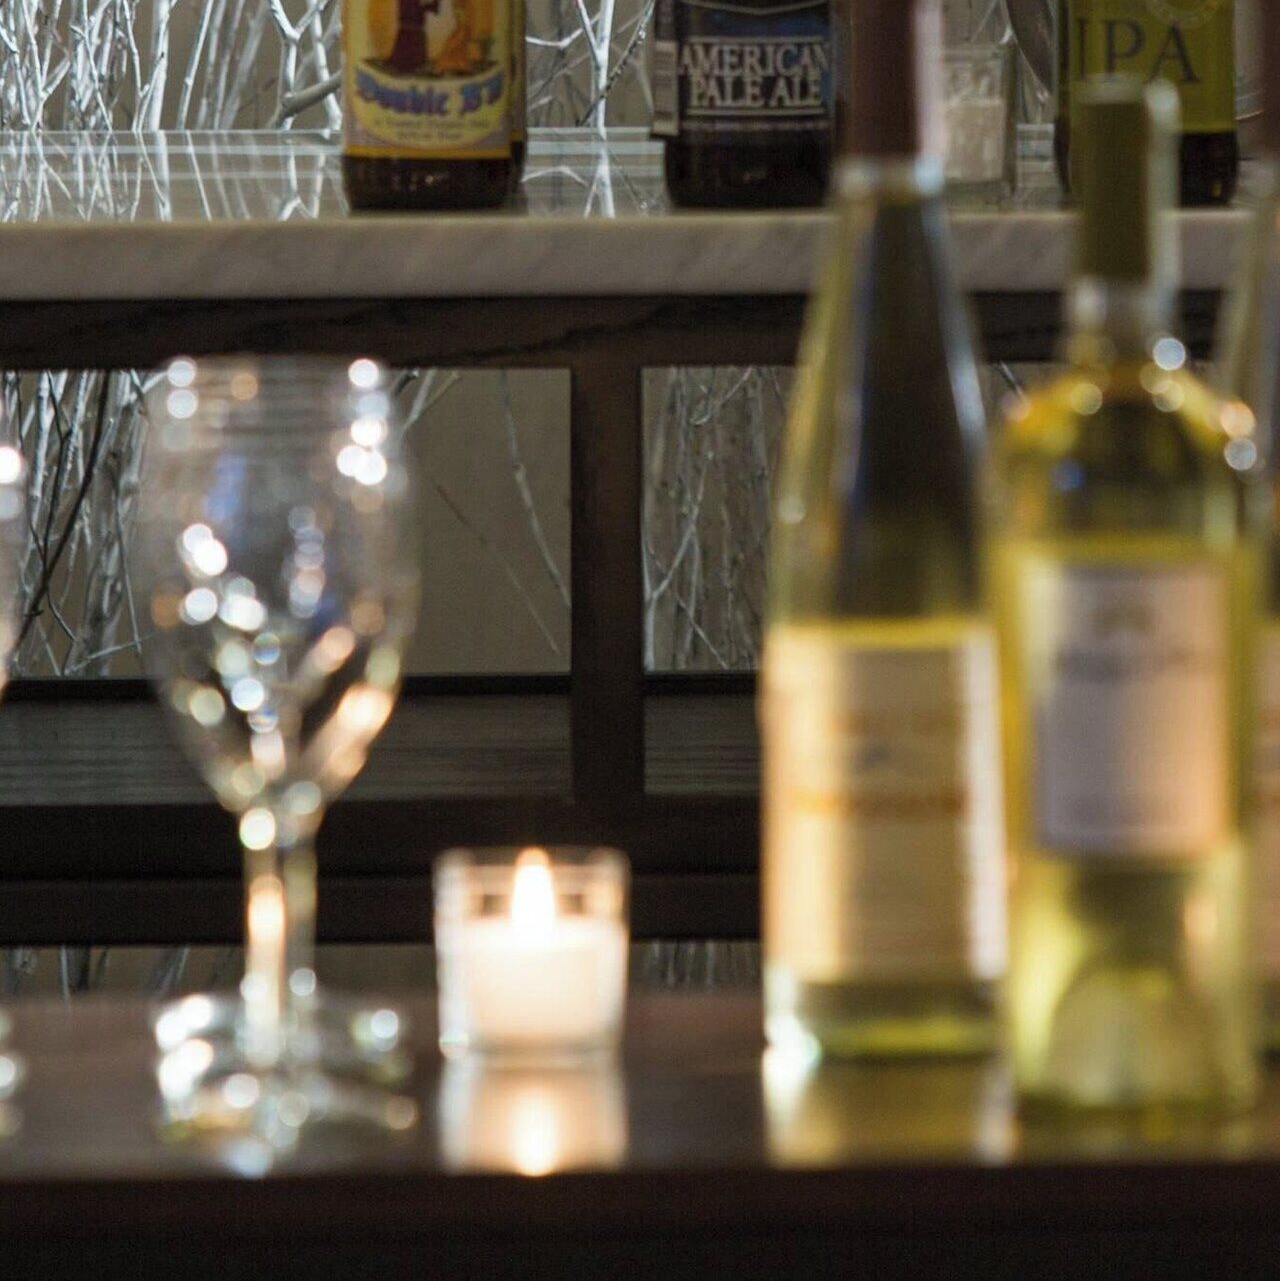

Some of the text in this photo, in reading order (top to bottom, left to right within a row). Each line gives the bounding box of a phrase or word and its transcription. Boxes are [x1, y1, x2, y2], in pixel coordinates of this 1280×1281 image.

[682, 44, 828, 77] AMERICAN
[1079, 19, 1200, 84] IPA
[690, 75, 821, 107] PALE ALE
